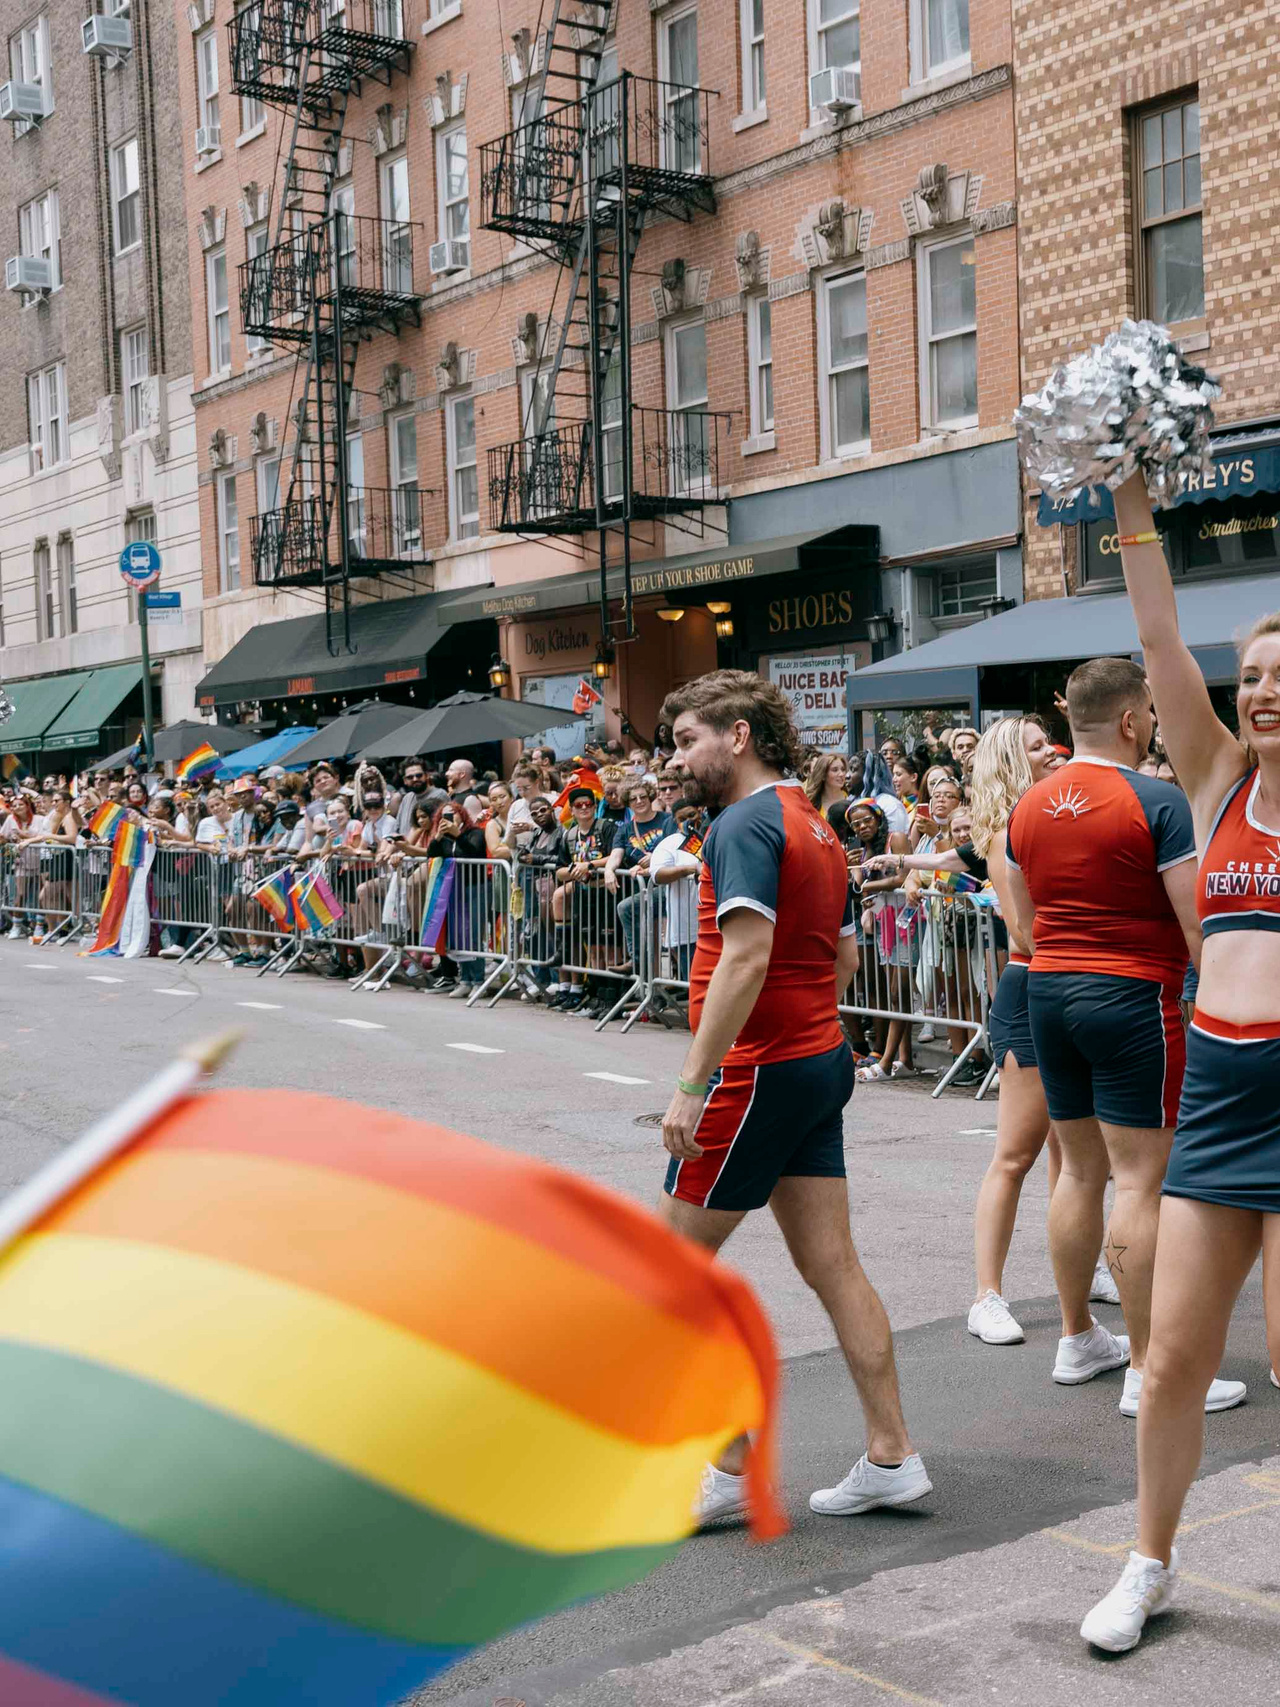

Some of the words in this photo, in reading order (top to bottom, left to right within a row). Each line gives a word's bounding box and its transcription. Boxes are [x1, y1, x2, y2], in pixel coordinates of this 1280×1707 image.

[1187, 459, 1255, 492] REY'S
[1199, 515, 1278, 541] Sandwiches
[631, 576, 648, 593] TEP
[665, 569, 693, 588] YOUR
[694, 564, 721, 583] SHOE
[723, 557, 755, 578] GAME
[768, 590, 853, 633] SHOES
[525, 632, 547, 660] Dog
[548, 627, 590, 653] Kitchen
[779, 673, 815, 690] JUICE
[792, 692, 803, 707] &
[804, 692, 836, 710] DELI
[817, 730, 840, 745] SOON
[1206, 872, 1251, 899] NEW
